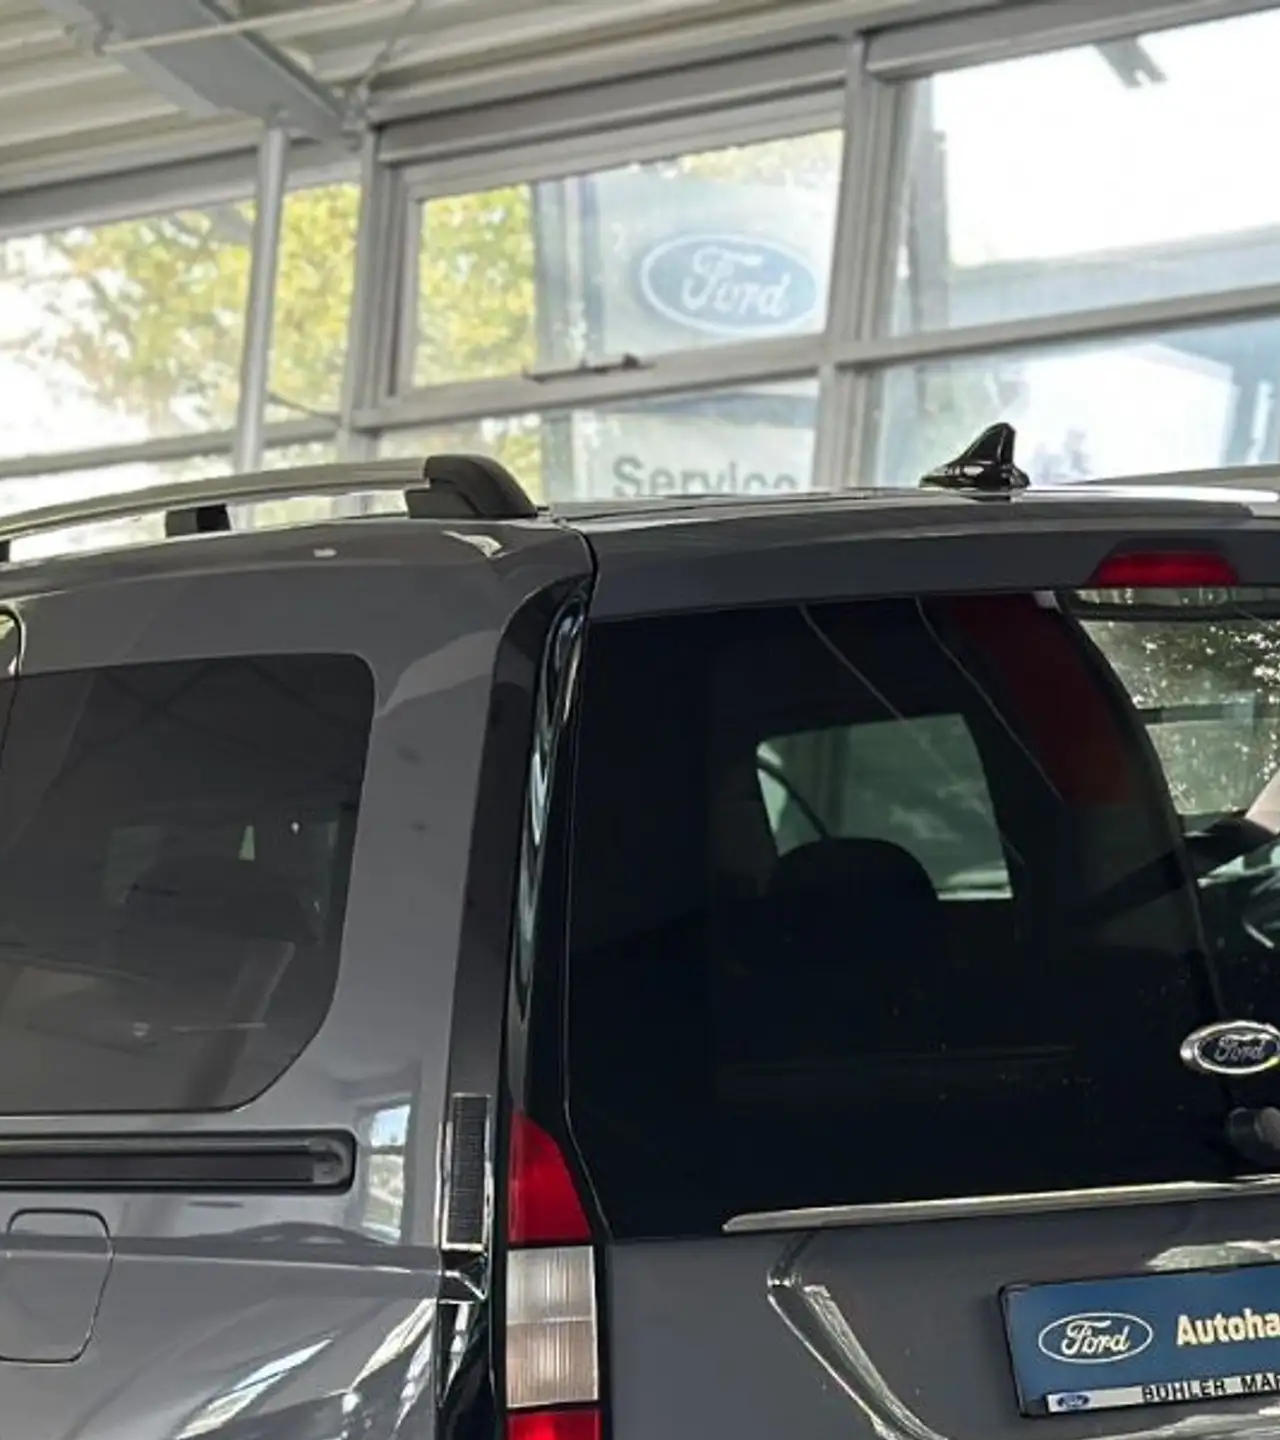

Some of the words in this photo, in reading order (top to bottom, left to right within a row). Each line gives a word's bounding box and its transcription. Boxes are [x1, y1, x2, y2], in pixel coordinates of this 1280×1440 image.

[681, 245, 791, 319] Ford
[612, 454, 798, 497] Service
[1061, 1319, 1131, 1356] Ford
